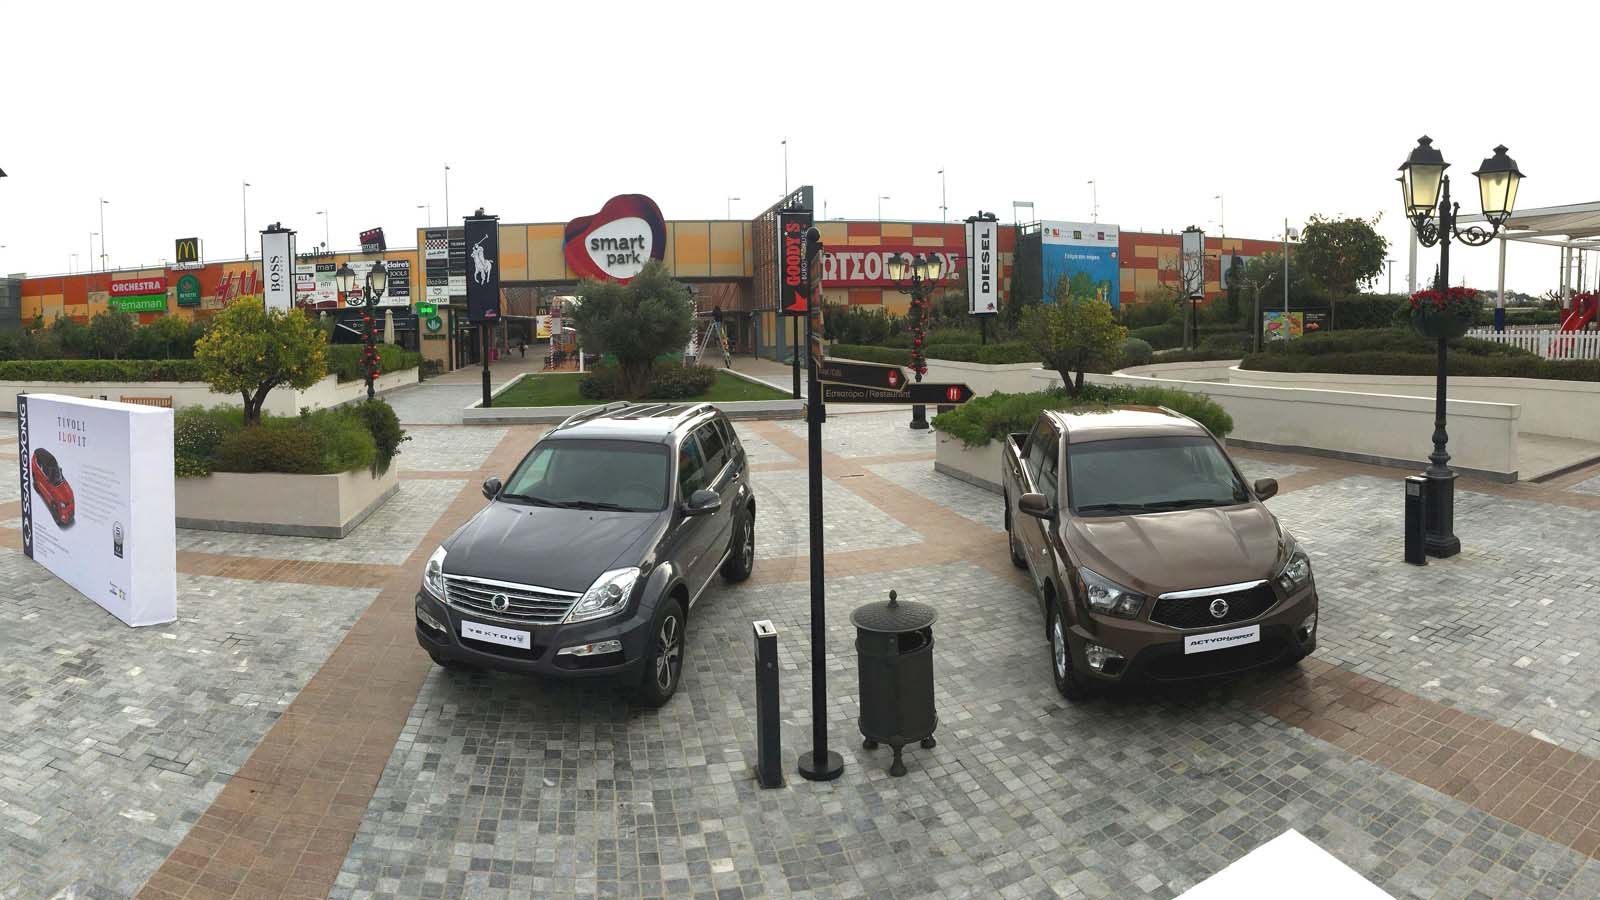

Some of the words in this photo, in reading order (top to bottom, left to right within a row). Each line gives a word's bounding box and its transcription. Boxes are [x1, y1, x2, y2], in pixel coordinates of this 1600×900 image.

[591, 234, 645, 250] smart
[606, 251, 641, 267] park
[982, 228, 990, 294] DIESEL
[270, 255, 280, 292] BOSS
[112, 281, 160, 292] ORCHESTRA
[57, 417, 85, 432] TIVOLI
[20, 403, 31, 513] SSANGYONG
